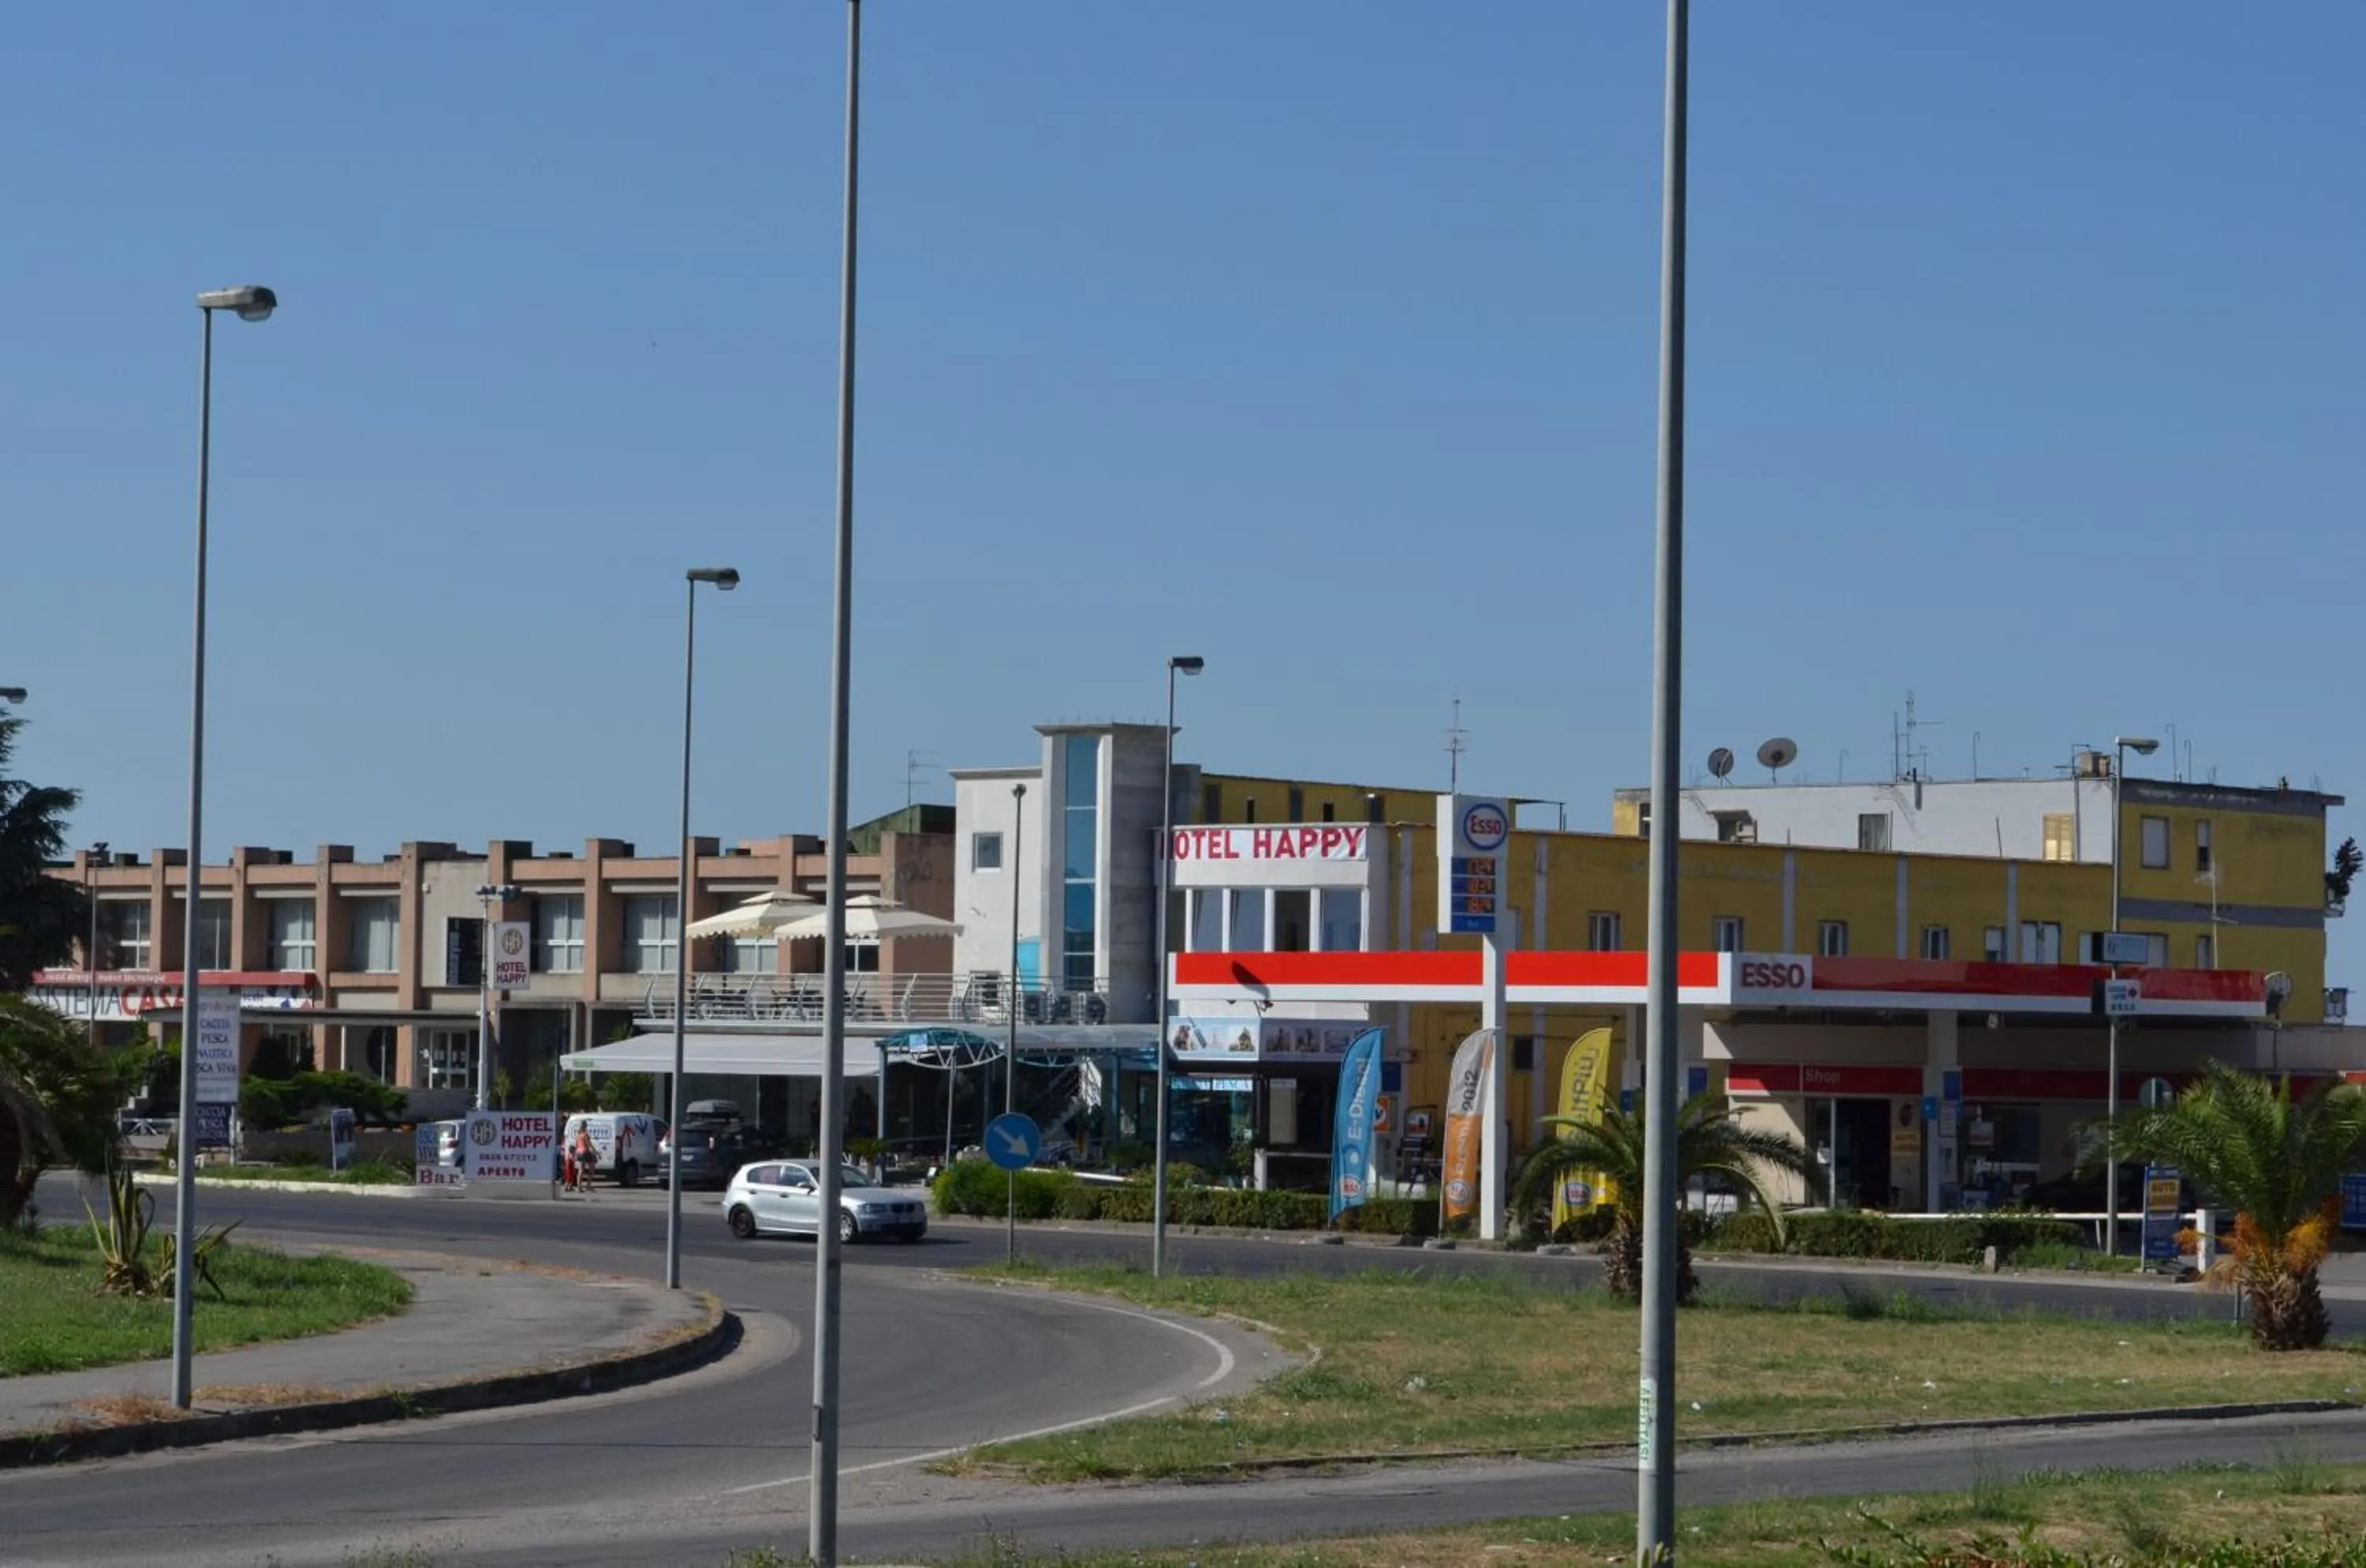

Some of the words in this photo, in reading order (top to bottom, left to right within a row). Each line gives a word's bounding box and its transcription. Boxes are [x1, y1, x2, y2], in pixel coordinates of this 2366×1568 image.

[1471, 815, 1502, 834] Esso
[1252, 827, 1364, 859] HAPPY
[496, 961, 527, 973] HOTEL
[496, 973, 526, 984] HAPPY
[1741, 962, 1805, 988] ESSO
[201, 1033, 230, 1044] PESCA
[1805, 1066, 1841, 1087] Shop
[501, 1117, 554, 1132] HOTEL
[501, 1135, 552, 1148] HAPPY
[419, 1169, 460, 1184] Bar
[477, 1167, 526, 1178] APERTO
